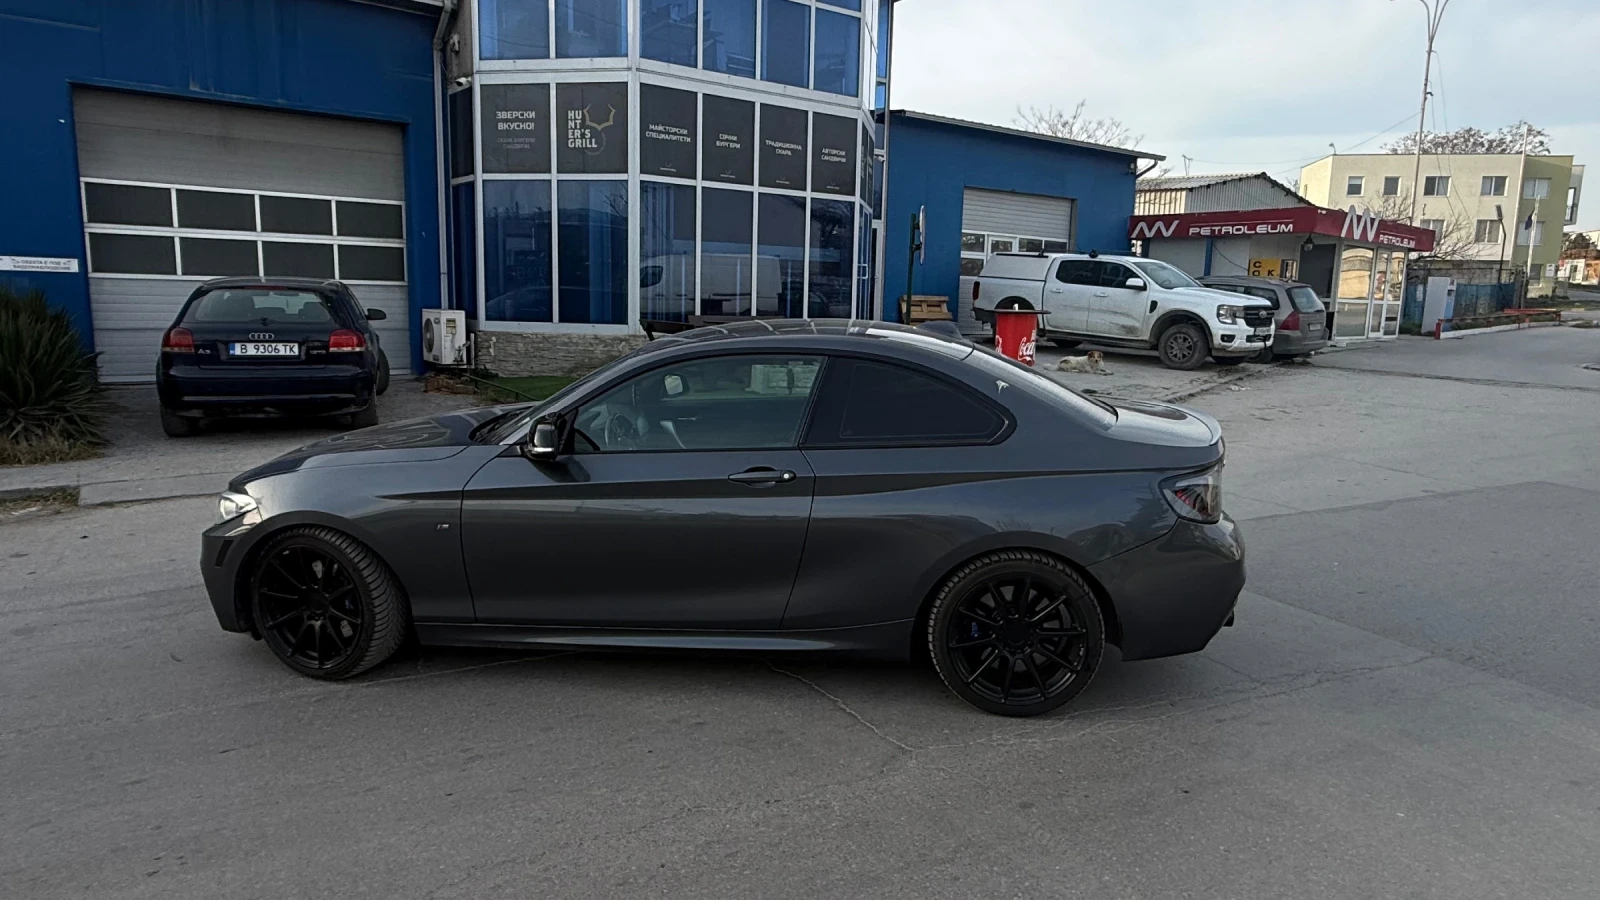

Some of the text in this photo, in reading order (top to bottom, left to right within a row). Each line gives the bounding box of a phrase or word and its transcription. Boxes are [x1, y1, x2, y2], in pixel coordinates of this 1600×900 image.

[496, 111, 535, 119] ЗВЕРСКИ
[568, 110, 582, 119] HU
[498, 122, 534, 130] ВКУСНО!
[568, 120, 581, 129] NT
[649, 124, 688, 134] МАЙСТОРСКИ
[568, 129, 590, 138] ER'S
[645, 131, 691, 142] СПЕЦИАЛИТЕТИ
[719, 133, 737, 141] СОЧНИ
[568, 139, 597, 148] GRILL
[716, 141, 740, 149] БУРГЕРИ
[1189, 224, 1293, 236] PETROLEUM
[1379, 234, 1416, 248] PETROLEUM
[240, 344, 296, 354] B 9306 TK
